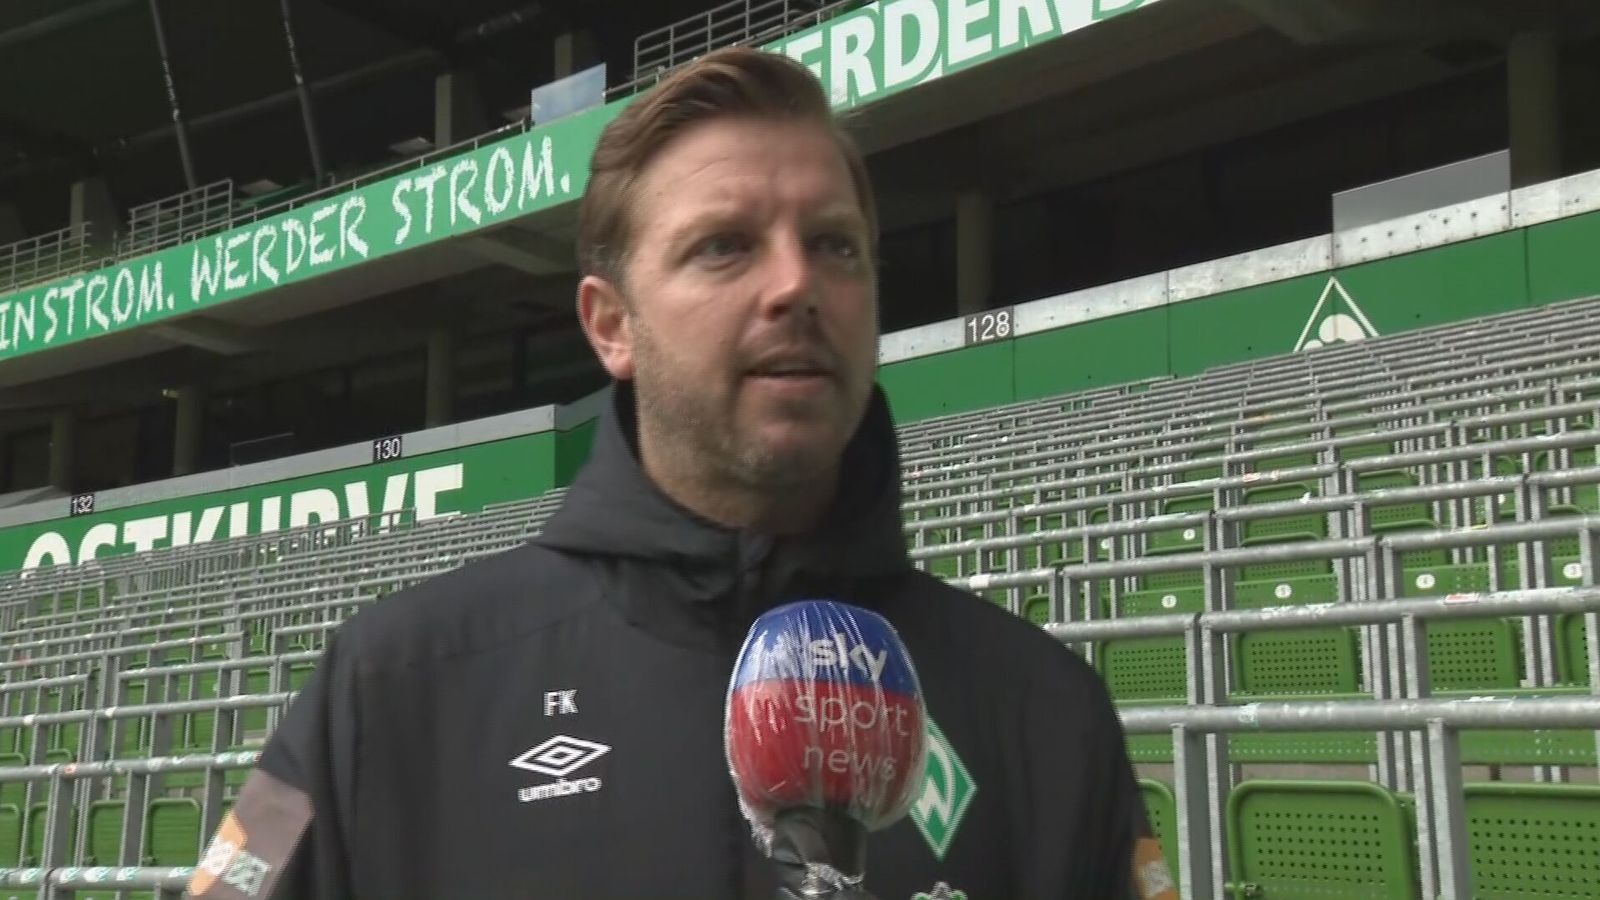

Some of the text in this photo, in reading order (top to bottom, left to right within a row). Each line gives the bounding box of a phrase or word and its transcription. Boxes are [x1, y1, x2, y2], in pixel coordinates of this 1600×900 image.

[758, 0, 1055, 107] RDER
[191, 195, 369, 303] WERDER
[393, 135, 570, 246] STROM.
[967, 311, 1010, 343] 128
[374, 438, 401, 461] 130
[71, 495, 93, 515] 132
[808, 632, 888, 681] sky
[543, 689, 579, 717] FK
[795, 695, 909, 736] sport
[803, 744, 897, 781] news
[517, 777, 603, 803] umbro
